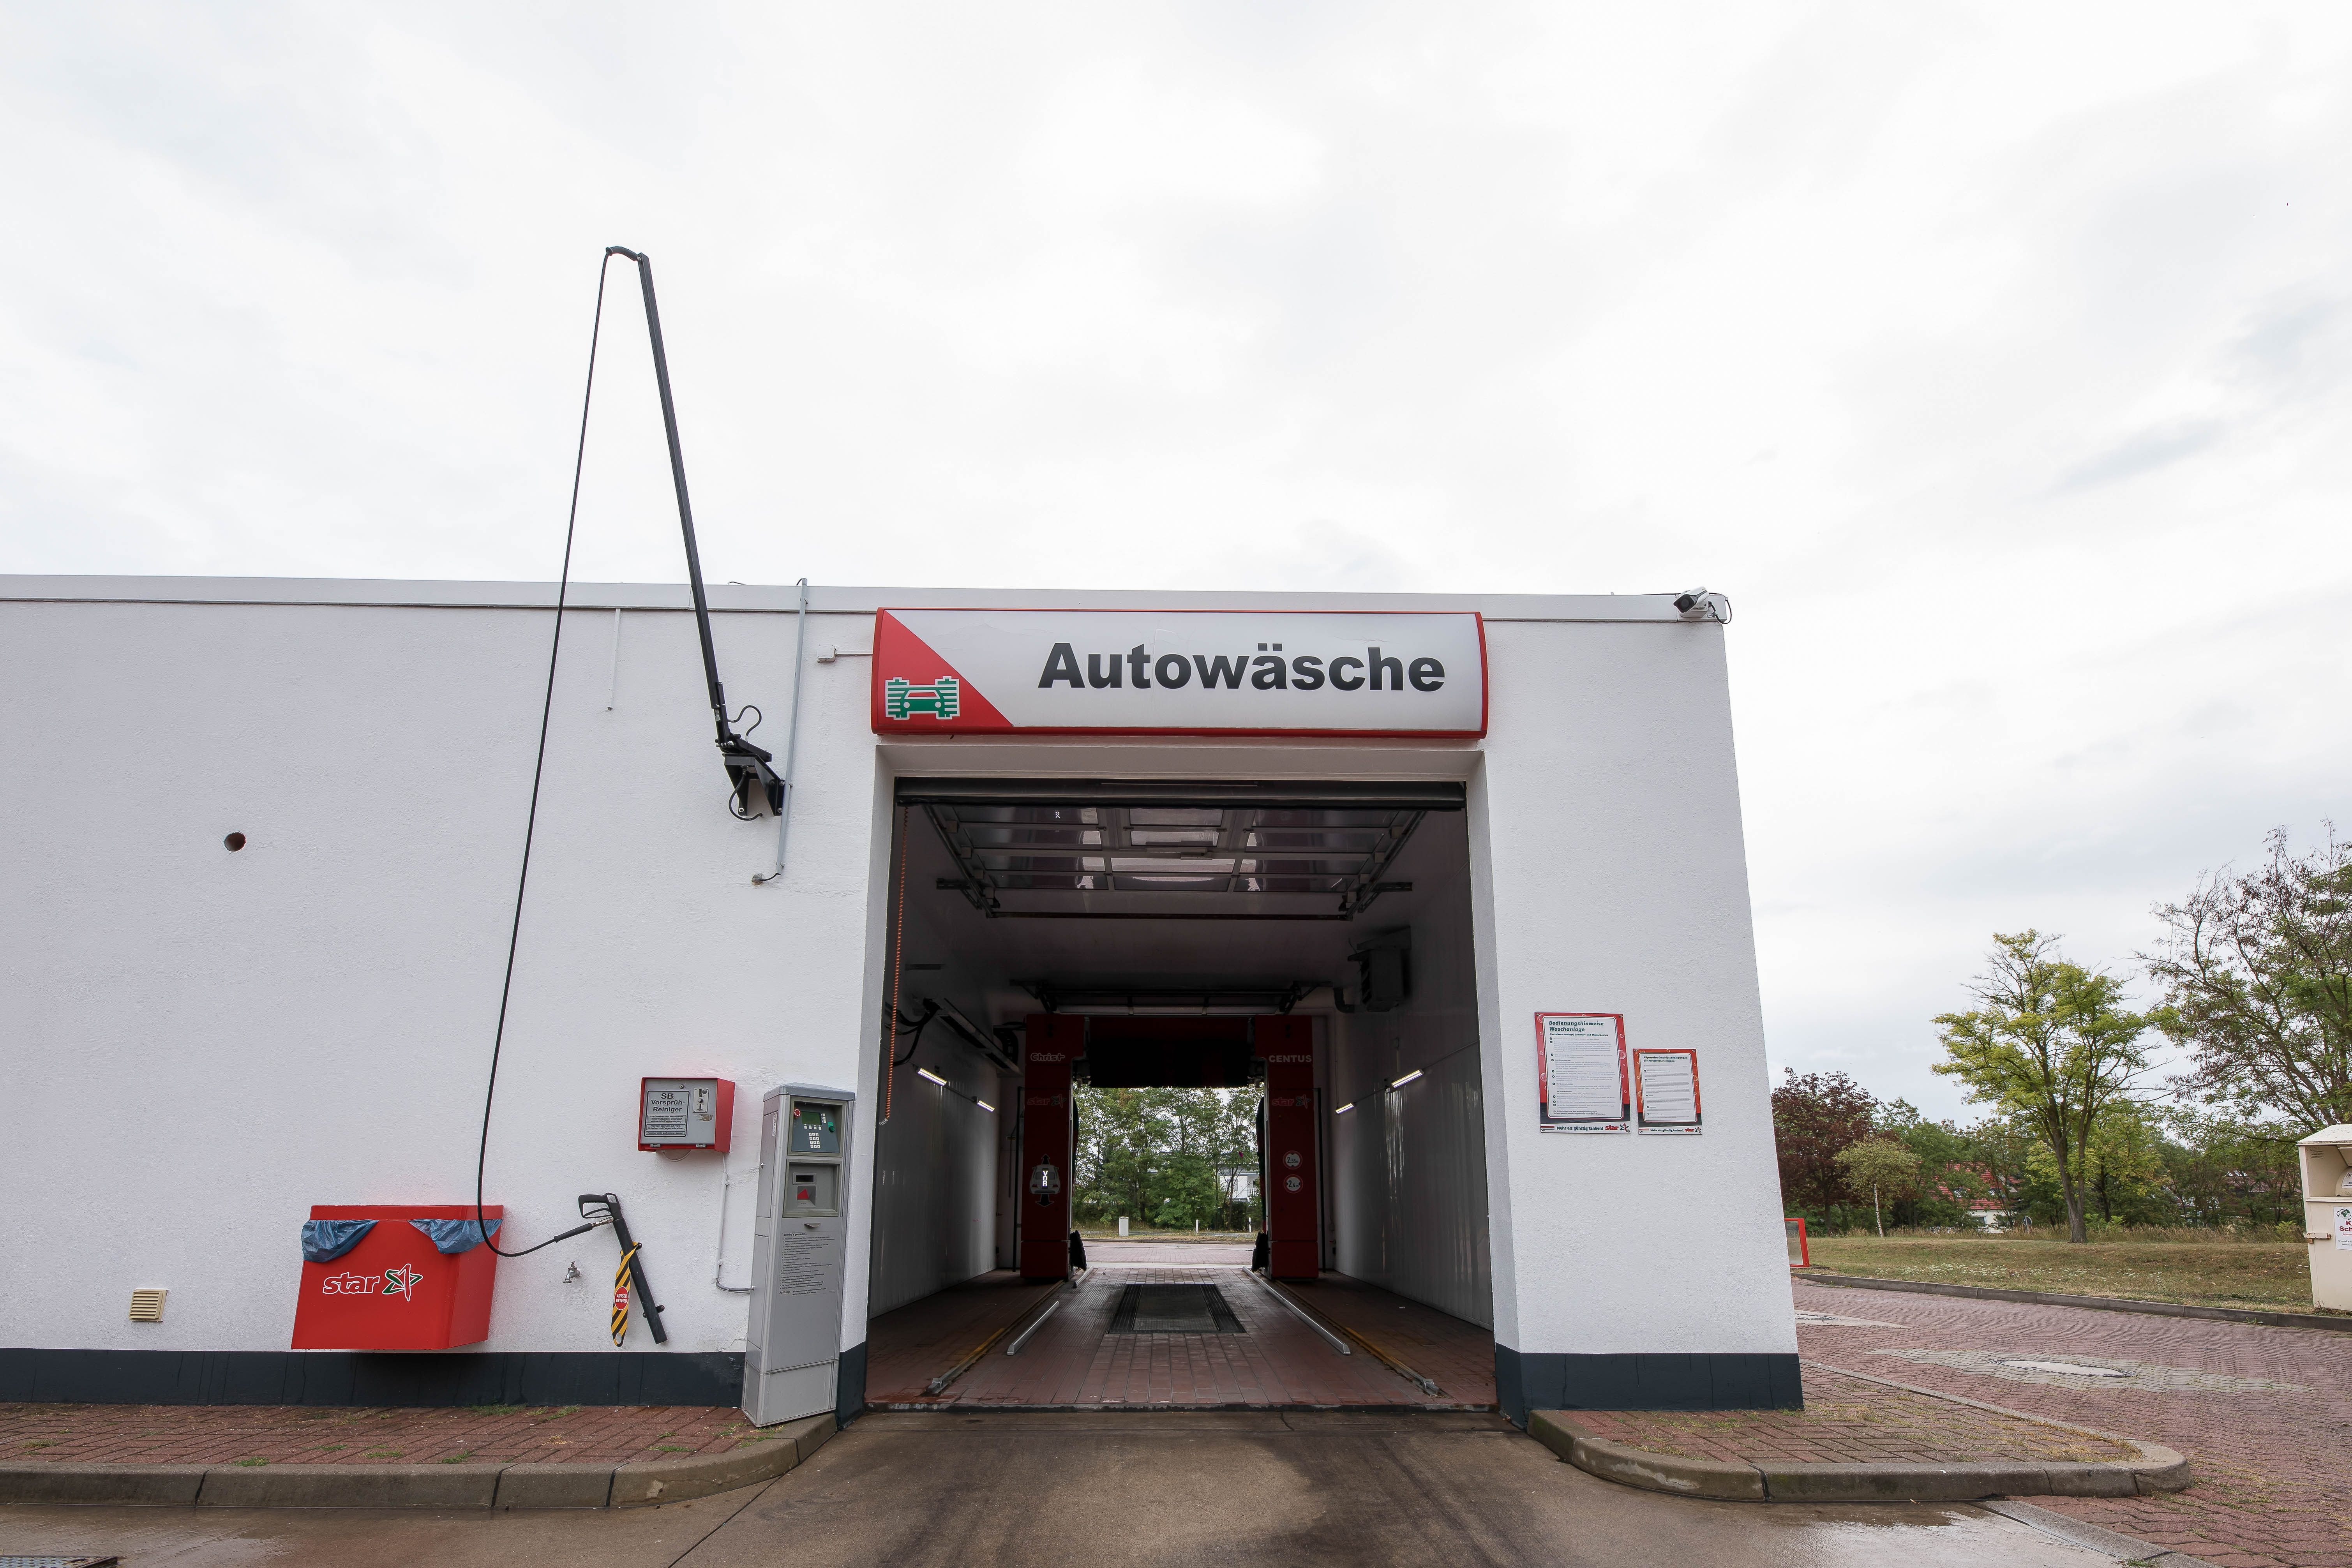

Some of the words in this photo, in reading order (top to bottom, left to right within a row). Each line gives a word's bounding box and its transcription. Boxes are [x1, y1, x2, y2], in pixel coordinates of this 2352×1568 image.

[1037, 642, 1446, 692] Autowäsche
[1030, 1052, 1066, 1062] Christ
[1268, 1055, 1312, 1063] CENTUS
[1027, 1096, 1050, 1106] star
[1271, 1097, 1295, 1106] star
[322, 1272, 380, 1295] star
